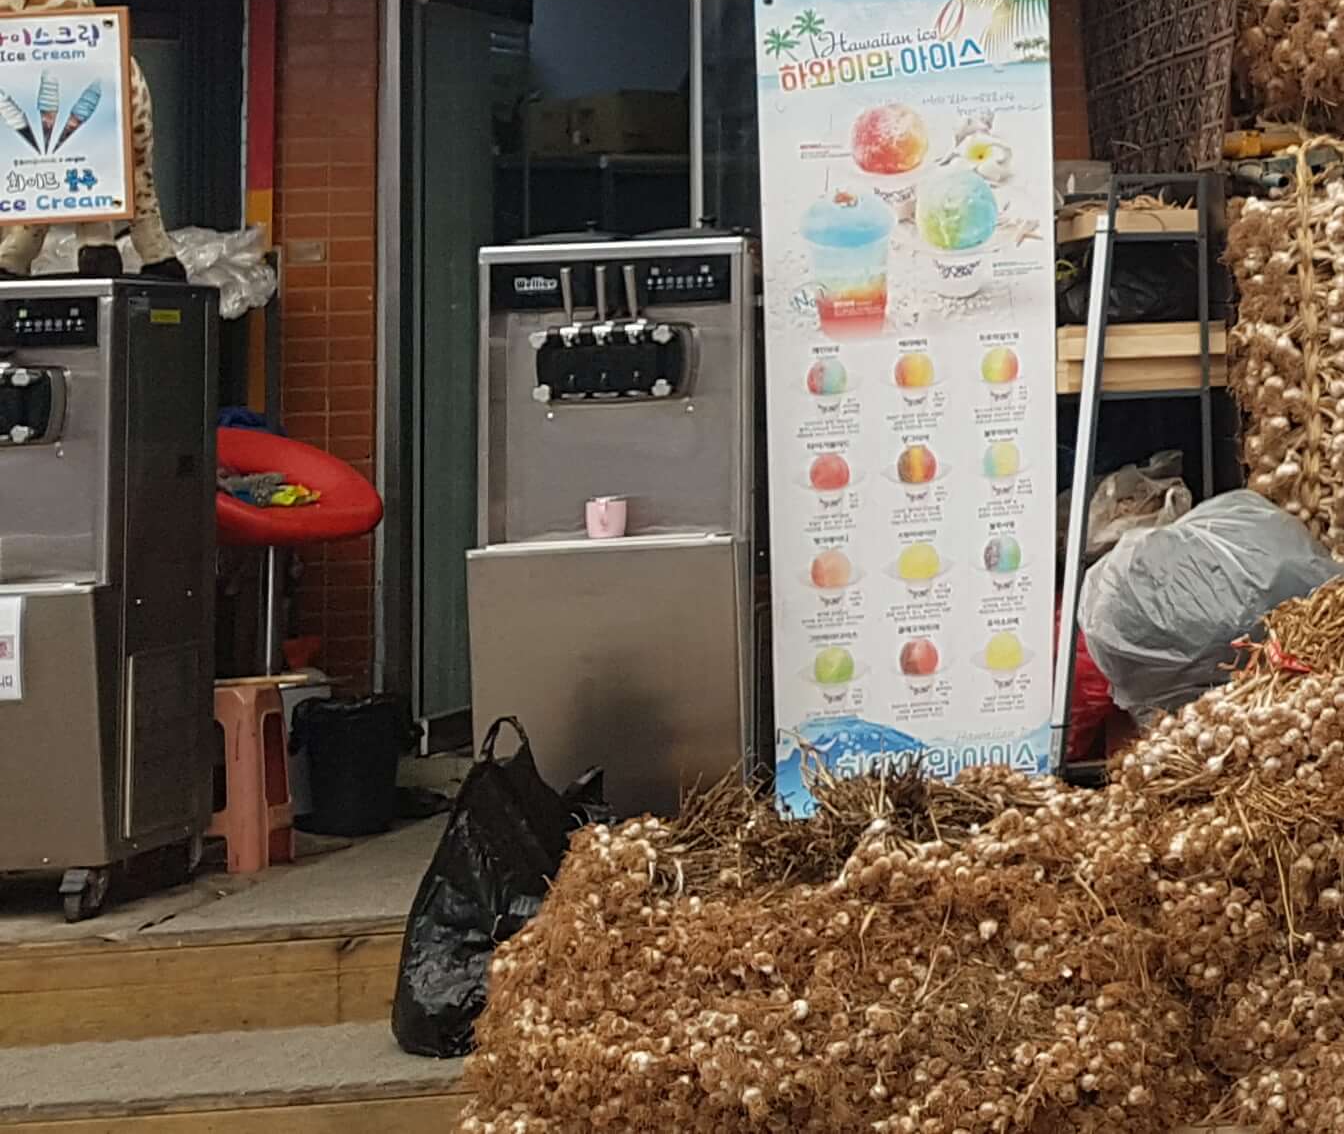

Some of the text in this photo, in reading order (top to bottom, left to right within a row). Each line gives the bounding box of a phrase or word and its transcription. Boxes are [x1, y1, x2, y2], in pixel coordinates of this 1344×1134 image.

[32, 48, 86, 61] Cream
[817, 28, 938, 57] Hawaiian ice
[778, 37, 986, 92] 하와이안 아이스
[36, 193, 114, 212] Cream
